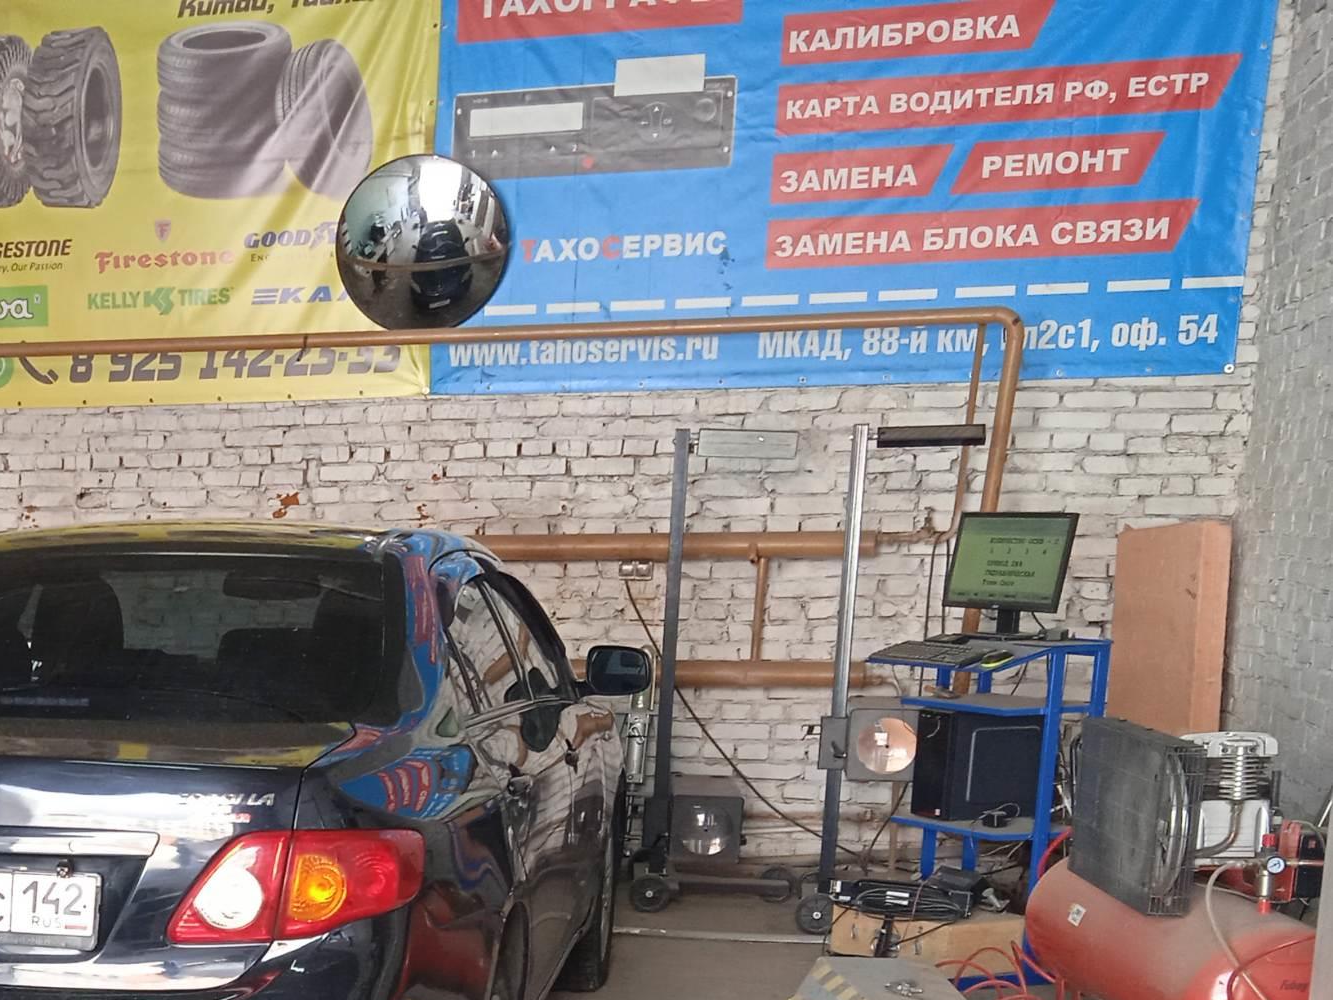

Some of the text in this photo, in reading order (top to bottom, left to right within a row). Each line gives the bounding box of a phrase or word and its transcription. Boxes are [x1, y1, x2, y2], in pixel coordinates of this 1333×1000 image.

[788, 14, 1021, 53] КАЛИБРОВКА
[785, 72, 1210, 120] КАРТА ВОДИТЕЛЯ РФ, ЕСТР
[779, 164, 918, 193] ЗАМЕНА
[981, 148, 1130, 179] РЕМОНТ
[520, 231, 727, 264] ТАХОСЕРВИС
[774, 216, 1171, 258] ЗАМЕНА БЛОКА СВЯЗИ
[11, 262, 28, 272] Our
[29, 261, 64, 271] Passion
[94, 250, 235, 274] Firestone
[87, 288, 232, 310] KELLY TIRES
[757, 328, 853, 361] МКАД,
[936, 327, 990, 357] км,
[1000, 318, 1100, 353] л2с1,
[1111, 316, 1166, 351] оф.
[1177, 313, 1219, 346] 54
[69, 352, 95, 383] 8
[108, 351, 183, 383] 925
[22, 880, 84, 917] 142
